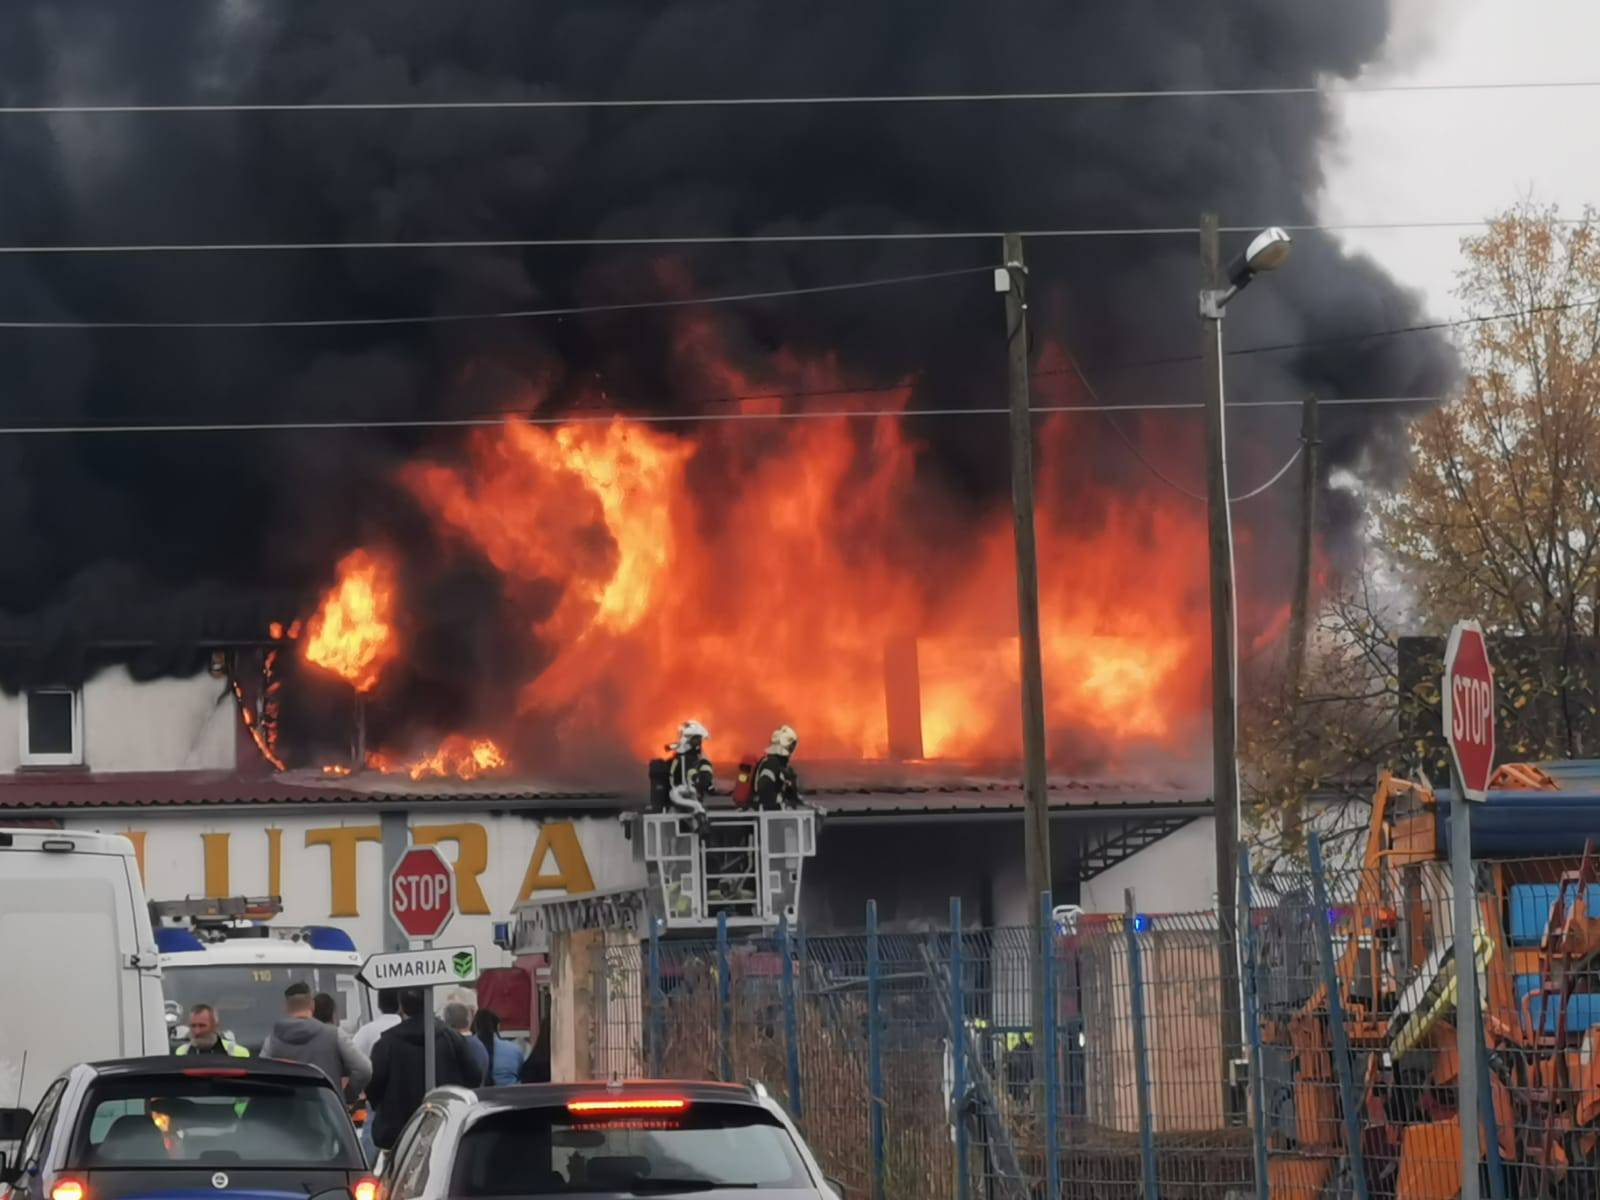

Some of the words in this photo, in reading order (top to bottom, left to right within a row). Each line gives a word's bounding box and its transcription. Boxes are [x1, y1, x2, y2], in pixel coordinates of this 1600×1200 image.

[1453, 674, 1490, 746] STOP
[394, 873, 448, 912] STOP
[375, 959, 447, 979] LIMARIJA
